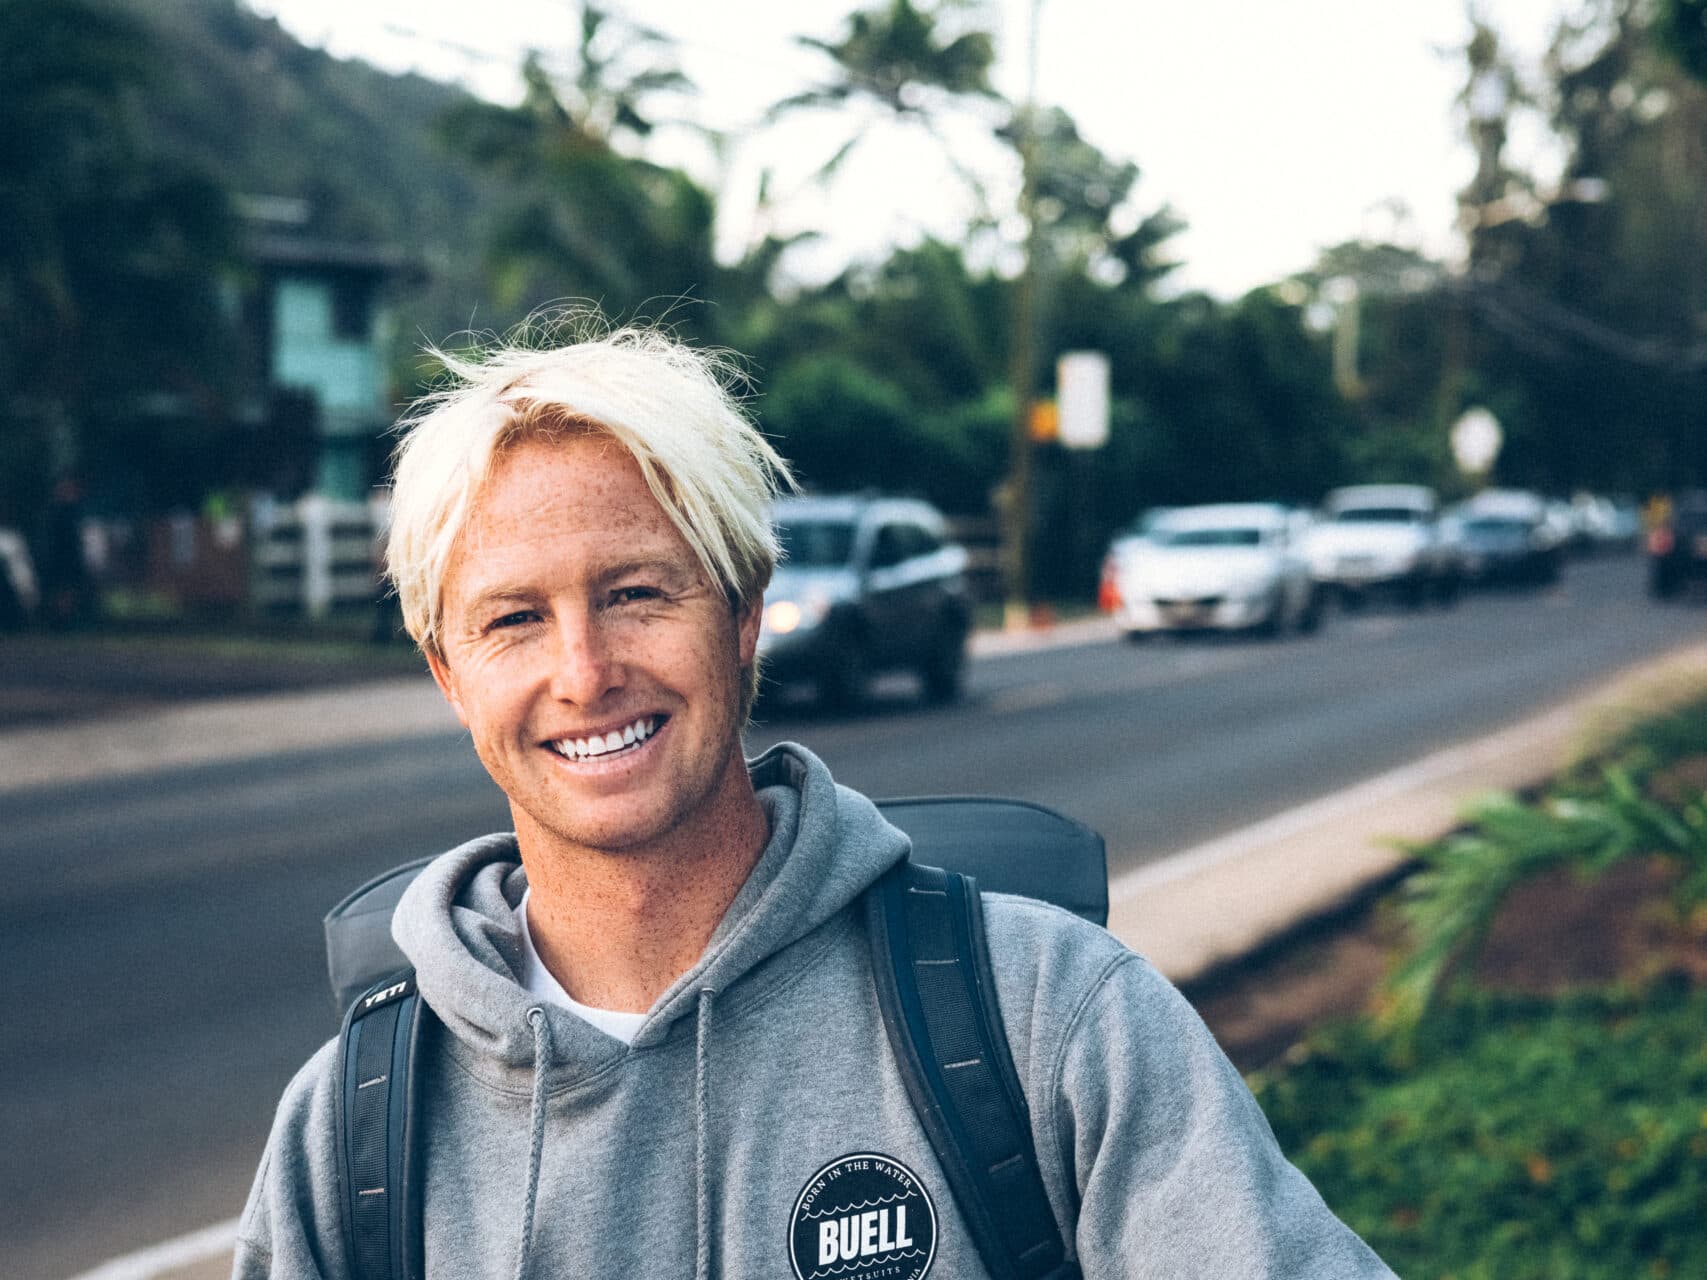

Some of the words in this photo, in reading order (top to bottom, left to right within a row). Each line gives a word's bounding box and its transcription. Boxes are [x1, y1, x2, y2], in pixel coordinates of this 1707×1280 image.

[365, 981, 407, 1007] YETI
[802, 1180, 826, 1211] BORN
[828, 1168, 841, 1181] IN
[845, 1161, 869, 1172] THE
[874, 1161, 912, 1189] WATER
[818, 1205, 913, 1266] BUELL
